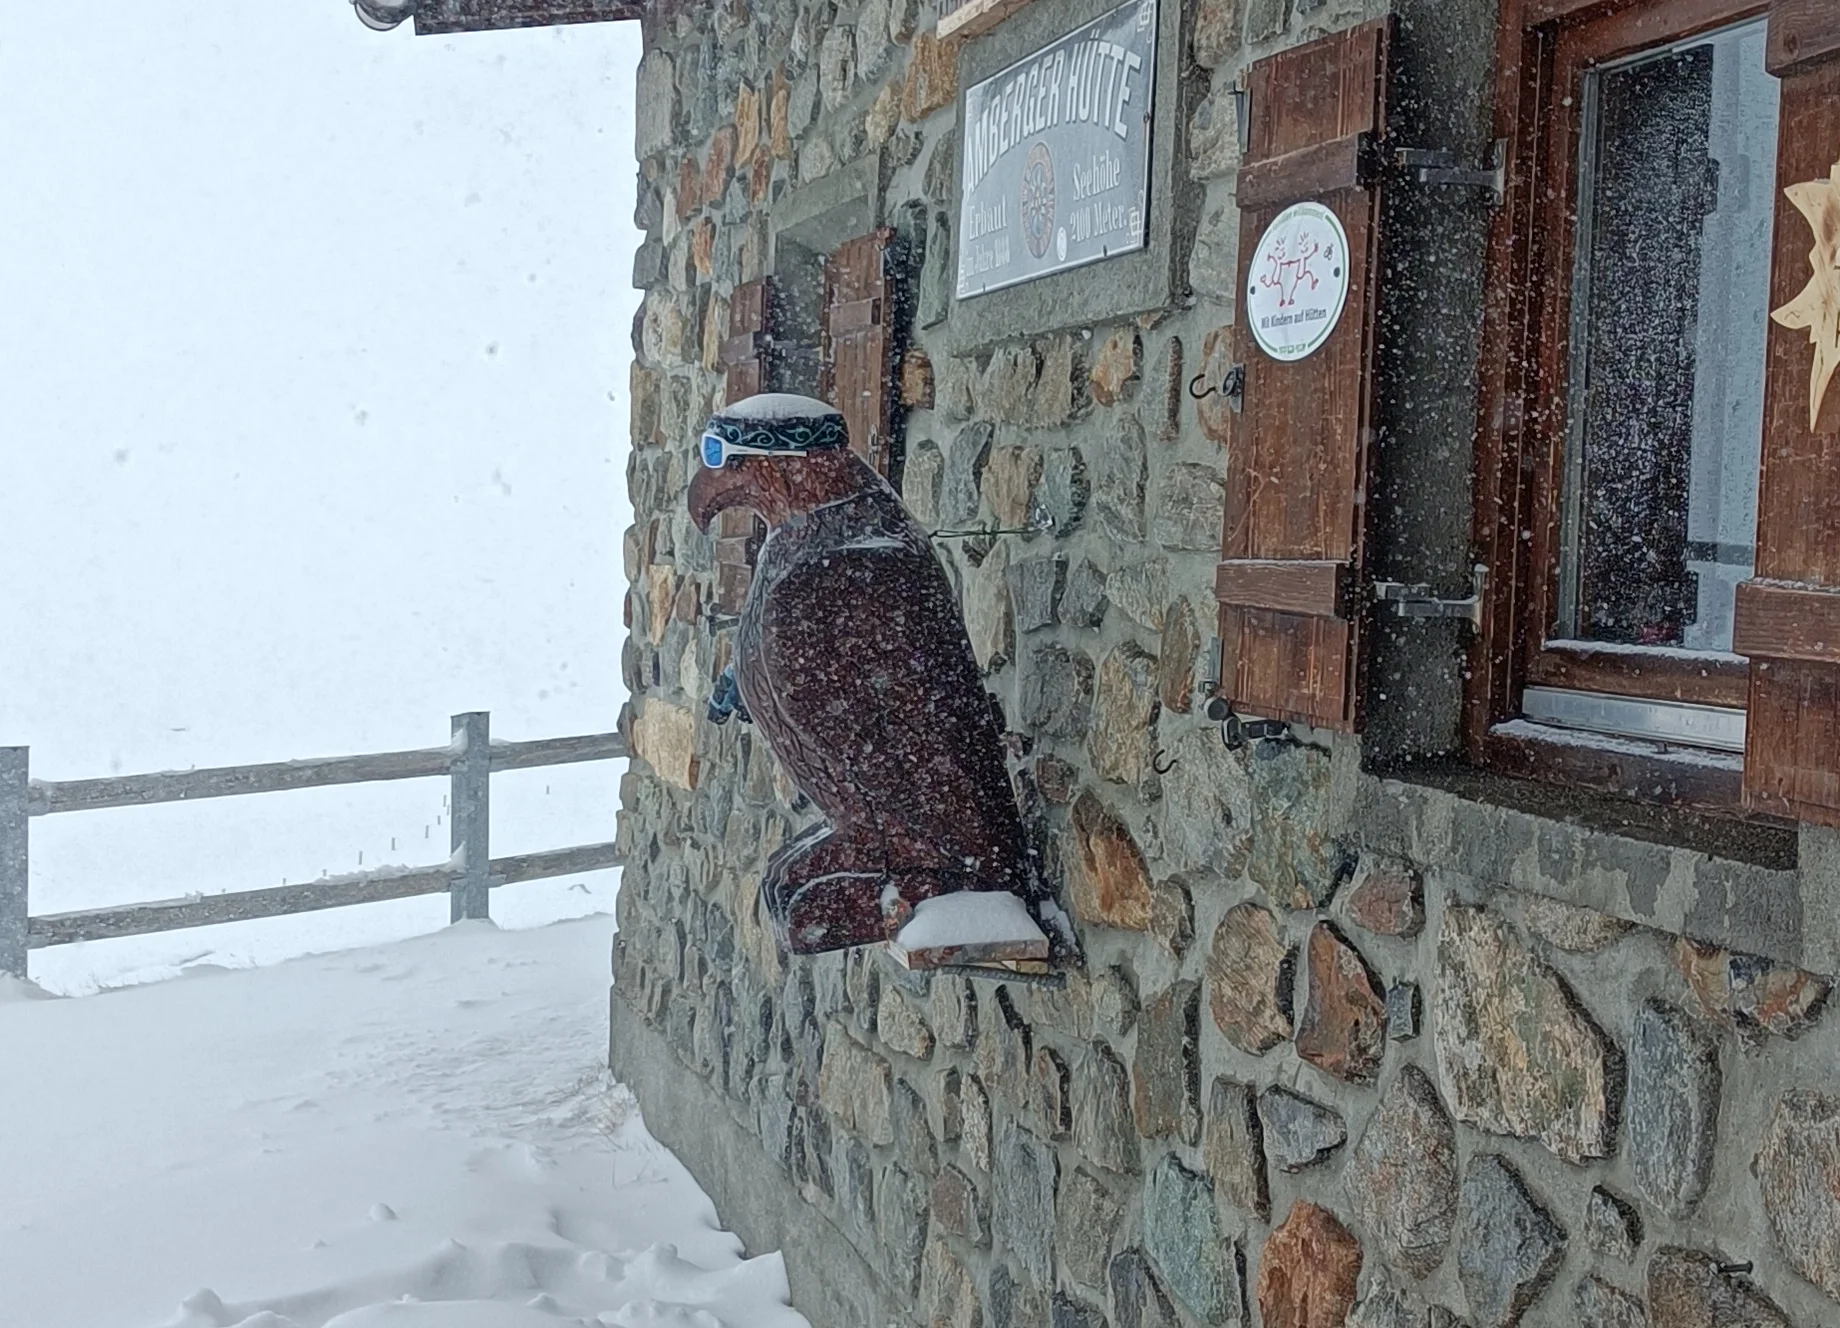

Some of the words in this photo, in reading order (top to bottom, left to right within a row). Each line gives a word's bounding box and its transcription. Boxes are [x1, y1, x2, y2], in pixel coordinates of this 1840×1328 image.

[963, 49, 1065, 197] AMBERGER
[1065, 30, 1141, 140] HÜTTE
[1073, 149, 1120, 202] Seehöhe
[969, 194, 1007, 241] Erbaut
[1070, 206, 1091, 242] 2100
[1261, 316, 1269, 329] Mit
[1270, 313, 1293, 327] Kindern
[1294, 309, 1304, 324] auf
[1305, 307, 1327, 321] Hütten
